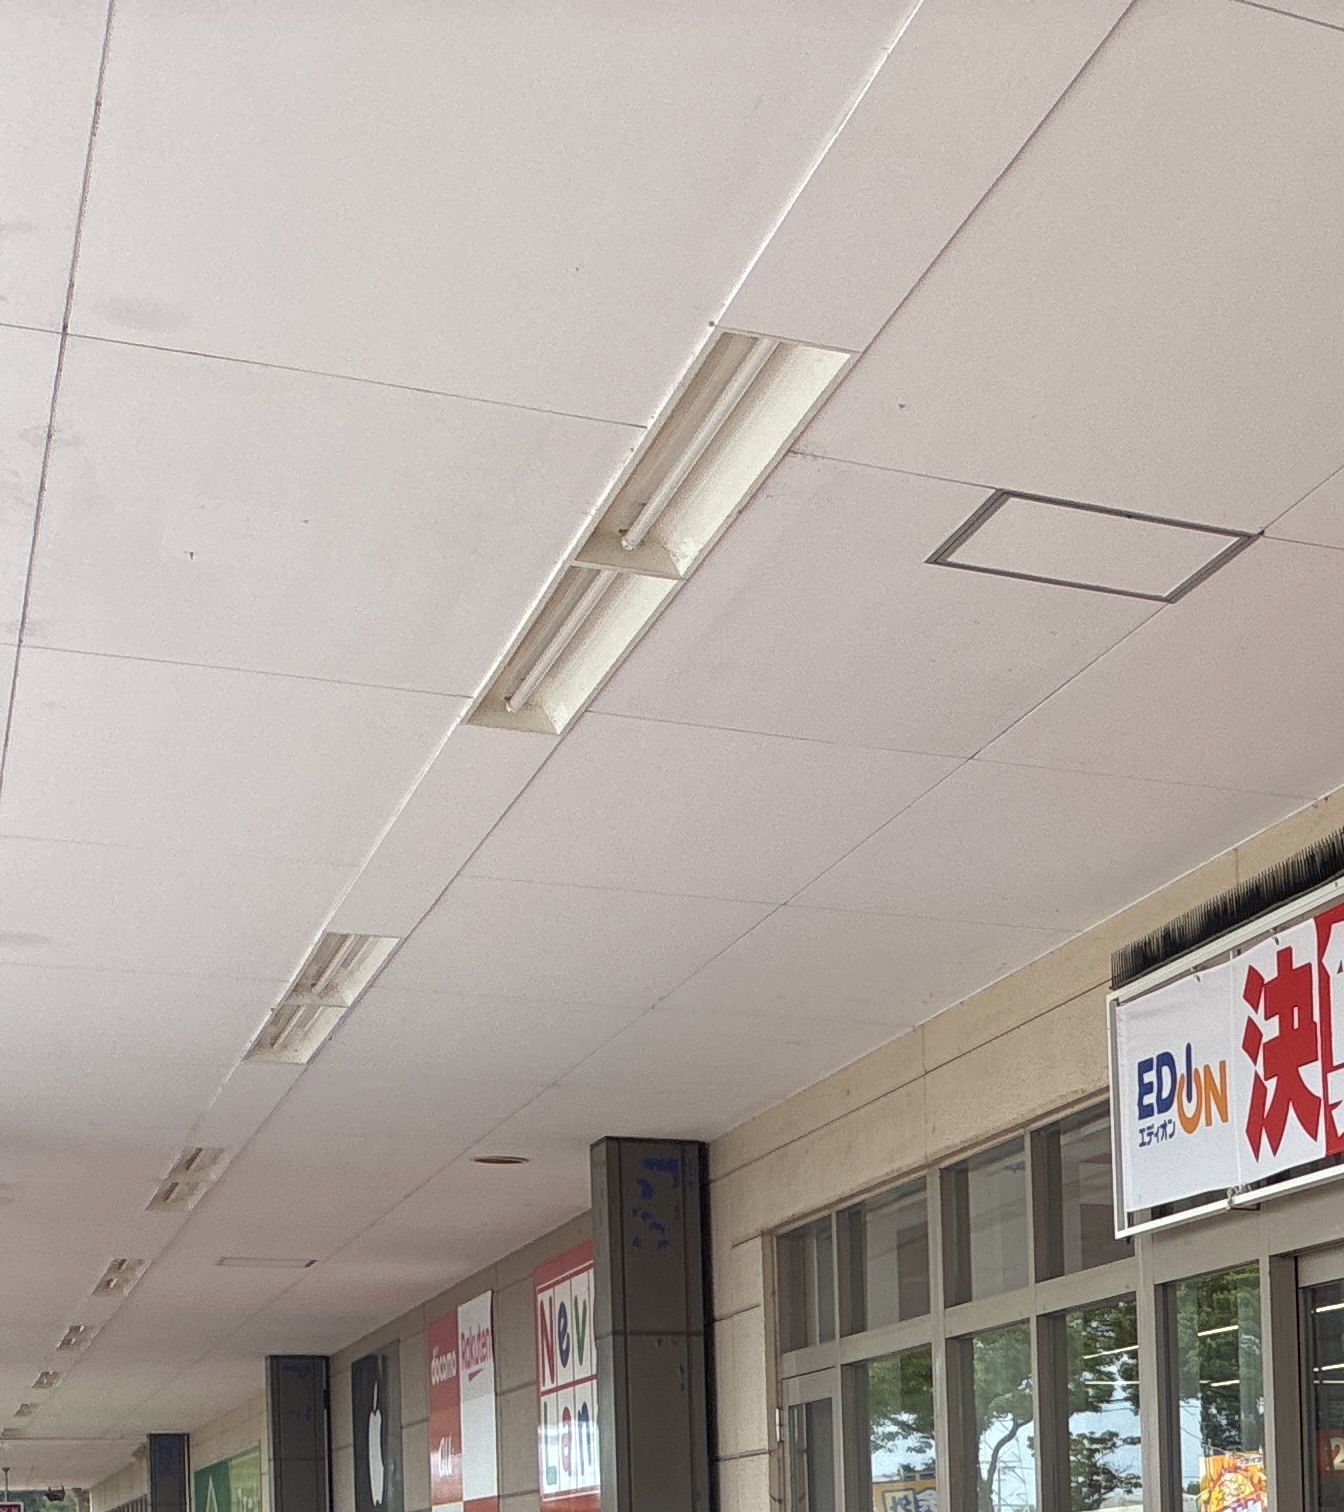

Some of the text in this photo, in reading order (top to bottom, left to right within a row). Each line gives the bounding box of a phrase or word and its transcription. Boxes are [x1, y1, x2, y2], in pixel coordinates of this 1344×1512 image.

[1136, 1043, 1230, 1135] EDION
[1138, 1118, 1177, 1148] エディオン
[431, 1347, 457, 1386] docomo
[460, 1325, 491, 1371] Rakuten
